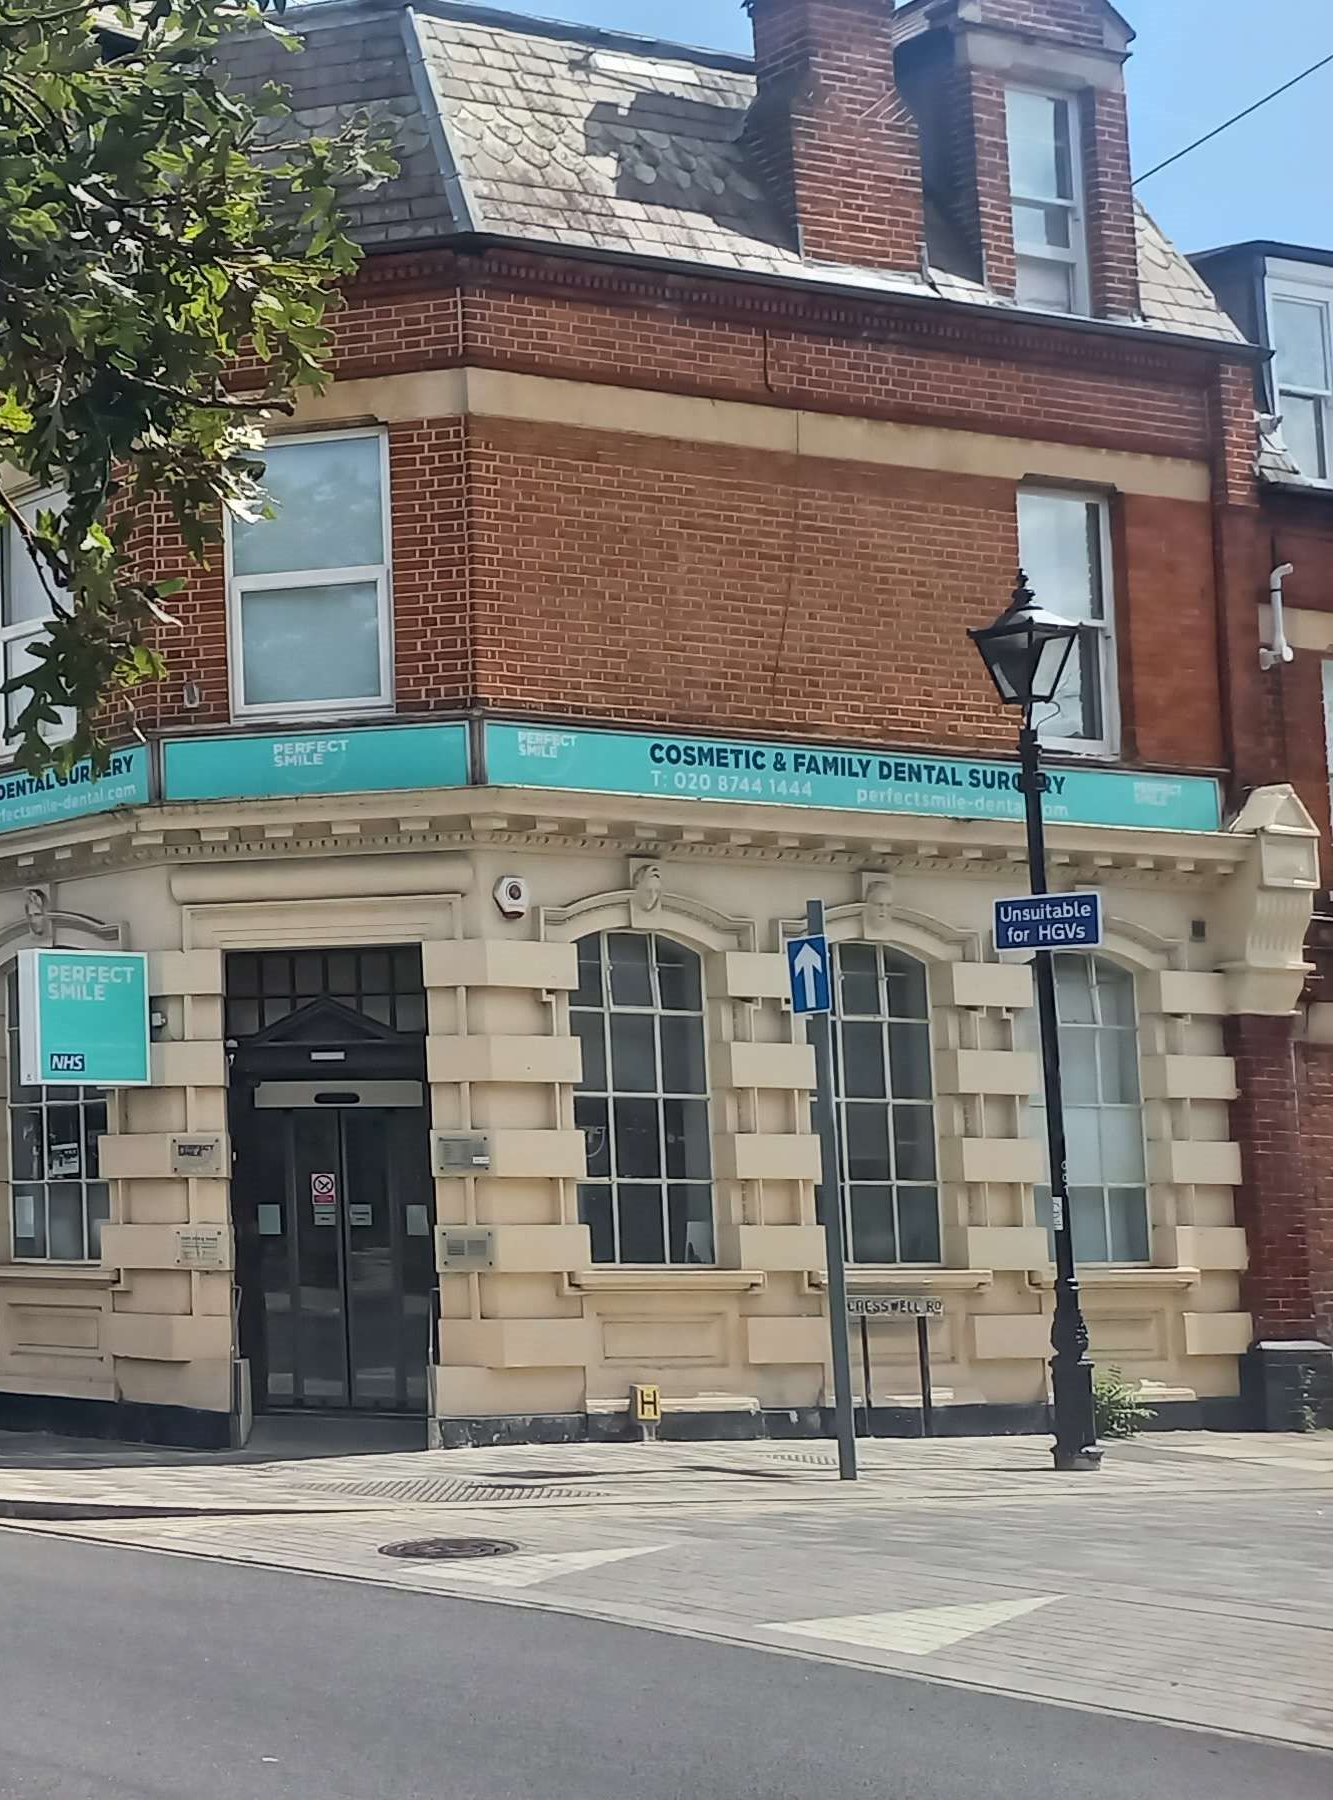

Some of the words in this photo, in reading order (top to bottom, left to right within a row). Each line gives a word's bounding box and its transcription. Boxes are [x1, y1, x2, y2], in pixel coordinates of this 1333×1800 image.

[273, 739, 350, 754] PERFECT
[273, 753, 325, 767] SMILE
[650, 743, 767, 770] COSMETIC
[773, 752, 787, 772] &
[793, 753, 872, 779] FAMILY
[878, 761, 963, 787] DENTAL
[651, 770, 668, 788] T:
[674, 771, 711, 791] 020
[718, 775, 764, 794] 8744
[769, 778, 813, 797] 1444
[1000, 901, 1091, 922] Unsuitable
[1007, 926, 1030, 943] for
[1038, 923, 1086, 940] HGVs
[48, 965, 134, 983] PERFECT
[48, 983, 106, 1001] SMILE
[51, 1055, 84, 1070] NHS
[641, 1390, 657, 1415] H
